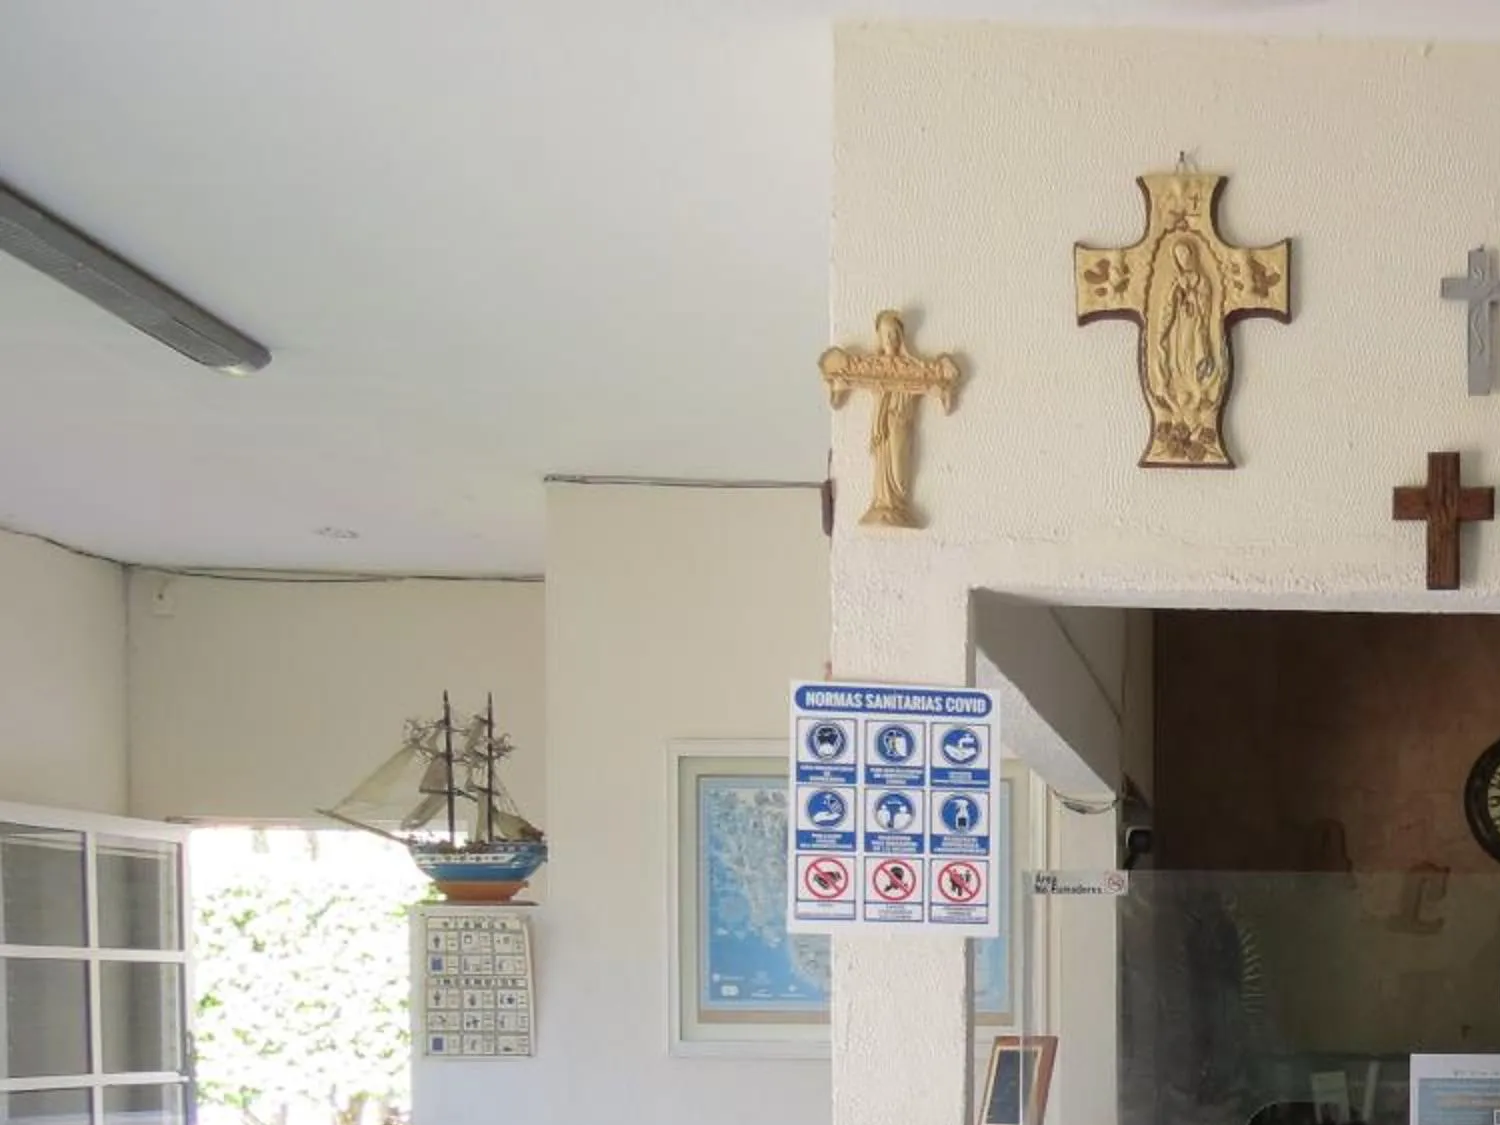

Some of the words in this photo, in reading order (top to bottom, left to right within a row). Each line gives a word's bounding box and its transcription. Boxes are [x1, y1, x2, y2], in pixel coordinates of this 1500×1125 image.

[805, 691, 863, 709] NORMAS
[865, 693, 943, 713] SANITARIAS
[945, 697, 987, 714] COVID
